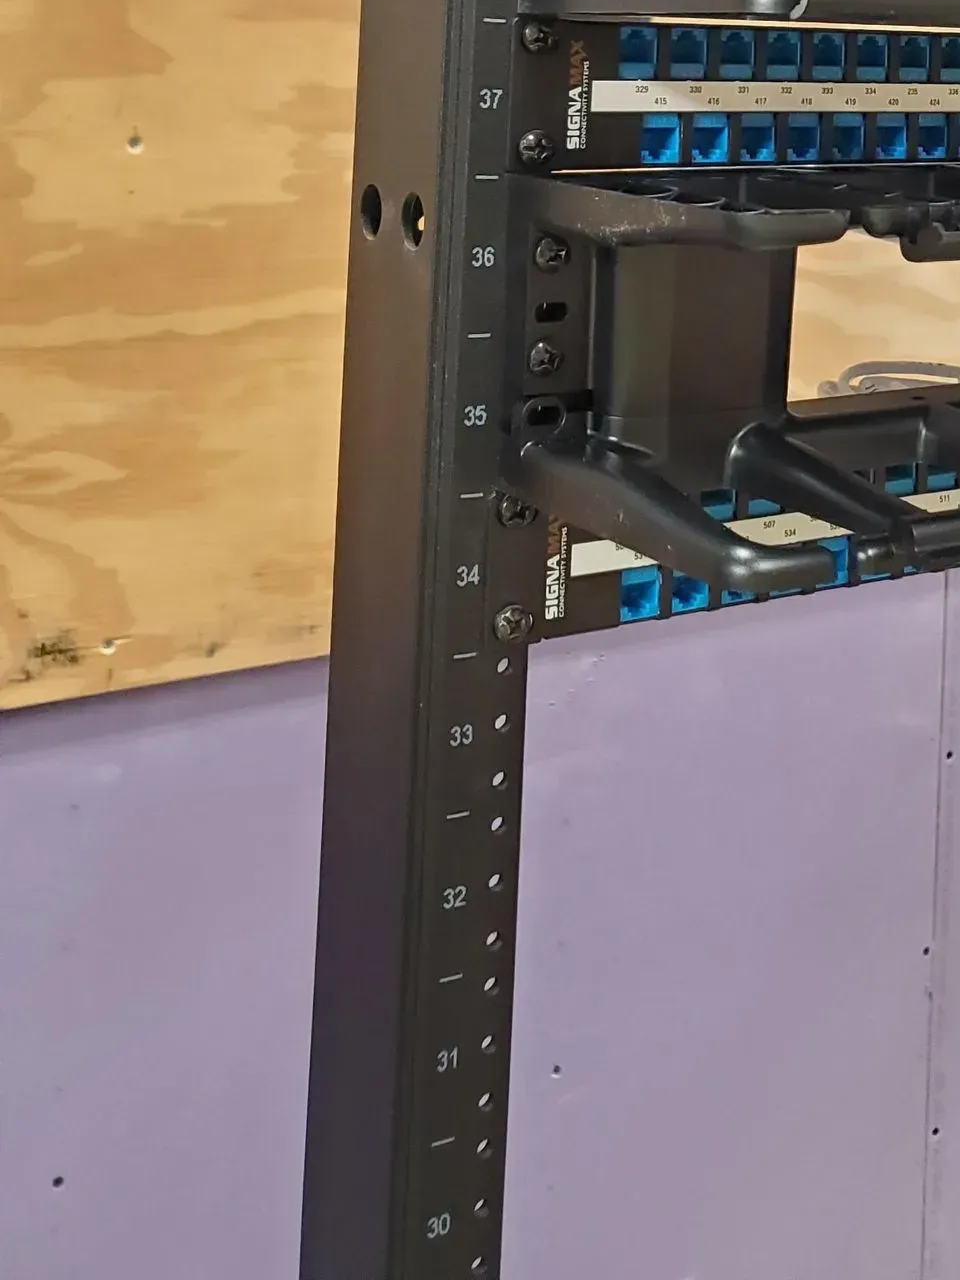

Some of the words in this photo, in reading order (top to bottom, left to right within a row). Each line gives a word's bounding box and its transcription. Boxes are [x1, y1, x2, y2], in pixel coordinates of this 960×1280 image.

[479, 88, 504, 110] 37
[567, 40, 588, 150] SIGNAMAX
[689, 86, 702, 94] 330
[738, 86, 749, 94] 331
[781, 86, 792, 94] 332
[654, 97, 667, 105] 415
[708, 97, 720, 105] 416
[845, 98, 856, 106] 419
[888, 98, 900, 106] 420
[929, 98, 940, 106] 424
[580, 93, 588, 149] CONNECTIVITY
[472, 246, 495, 268] 36
[464, 404, 488, 426] 35
[940, 494, 950, 503] 511
[764, 520, 776, 529] 507
[784, 528, 796, 538] 534
[456, 564, 480, 587] 34
[450, 724, 473, 747] 33
[442, 886, 466, 909] 32
[436, 1046, 458, 1072] 31
[427, 1212, 451, 1239] 30
